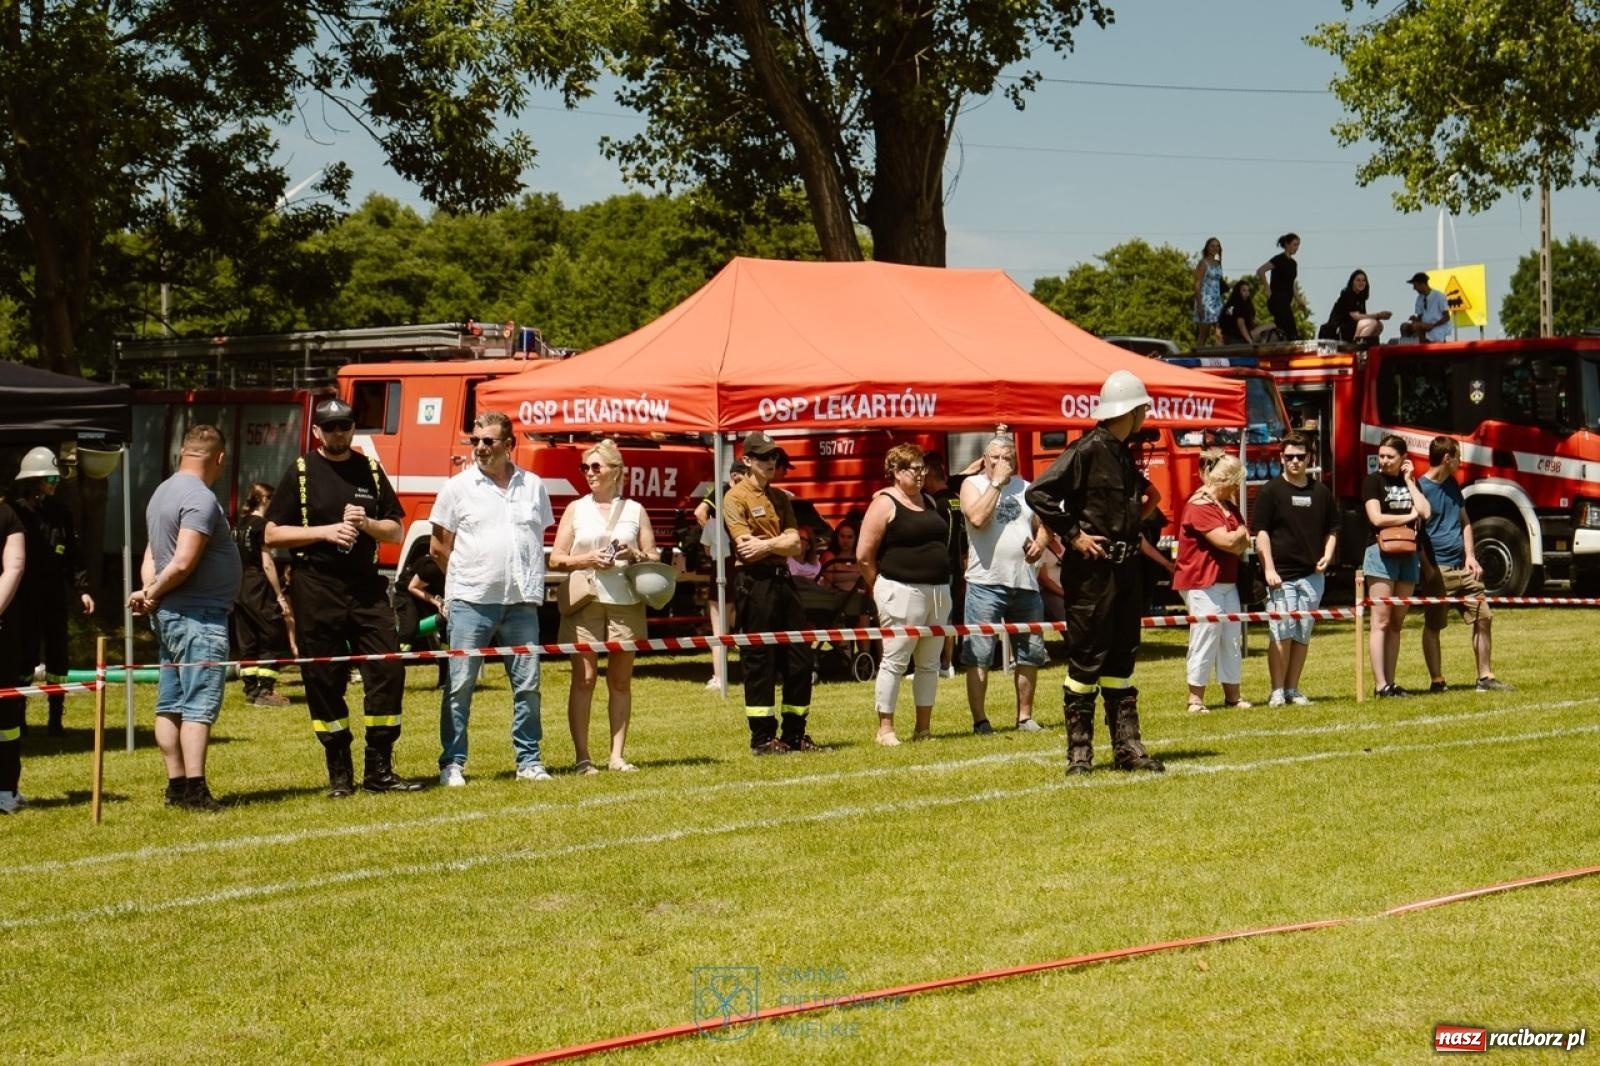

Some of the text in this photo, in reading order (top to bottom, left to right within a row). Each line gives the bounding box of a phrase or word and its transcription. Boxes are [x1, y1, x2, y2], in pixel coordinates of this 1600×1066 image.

[518, 392, 670, 425] OSP LEKARTÓW
[758, 388, 937, 422] OSP LEKARTÓW
[1145, 392, 1215, 420] ARTÓW
